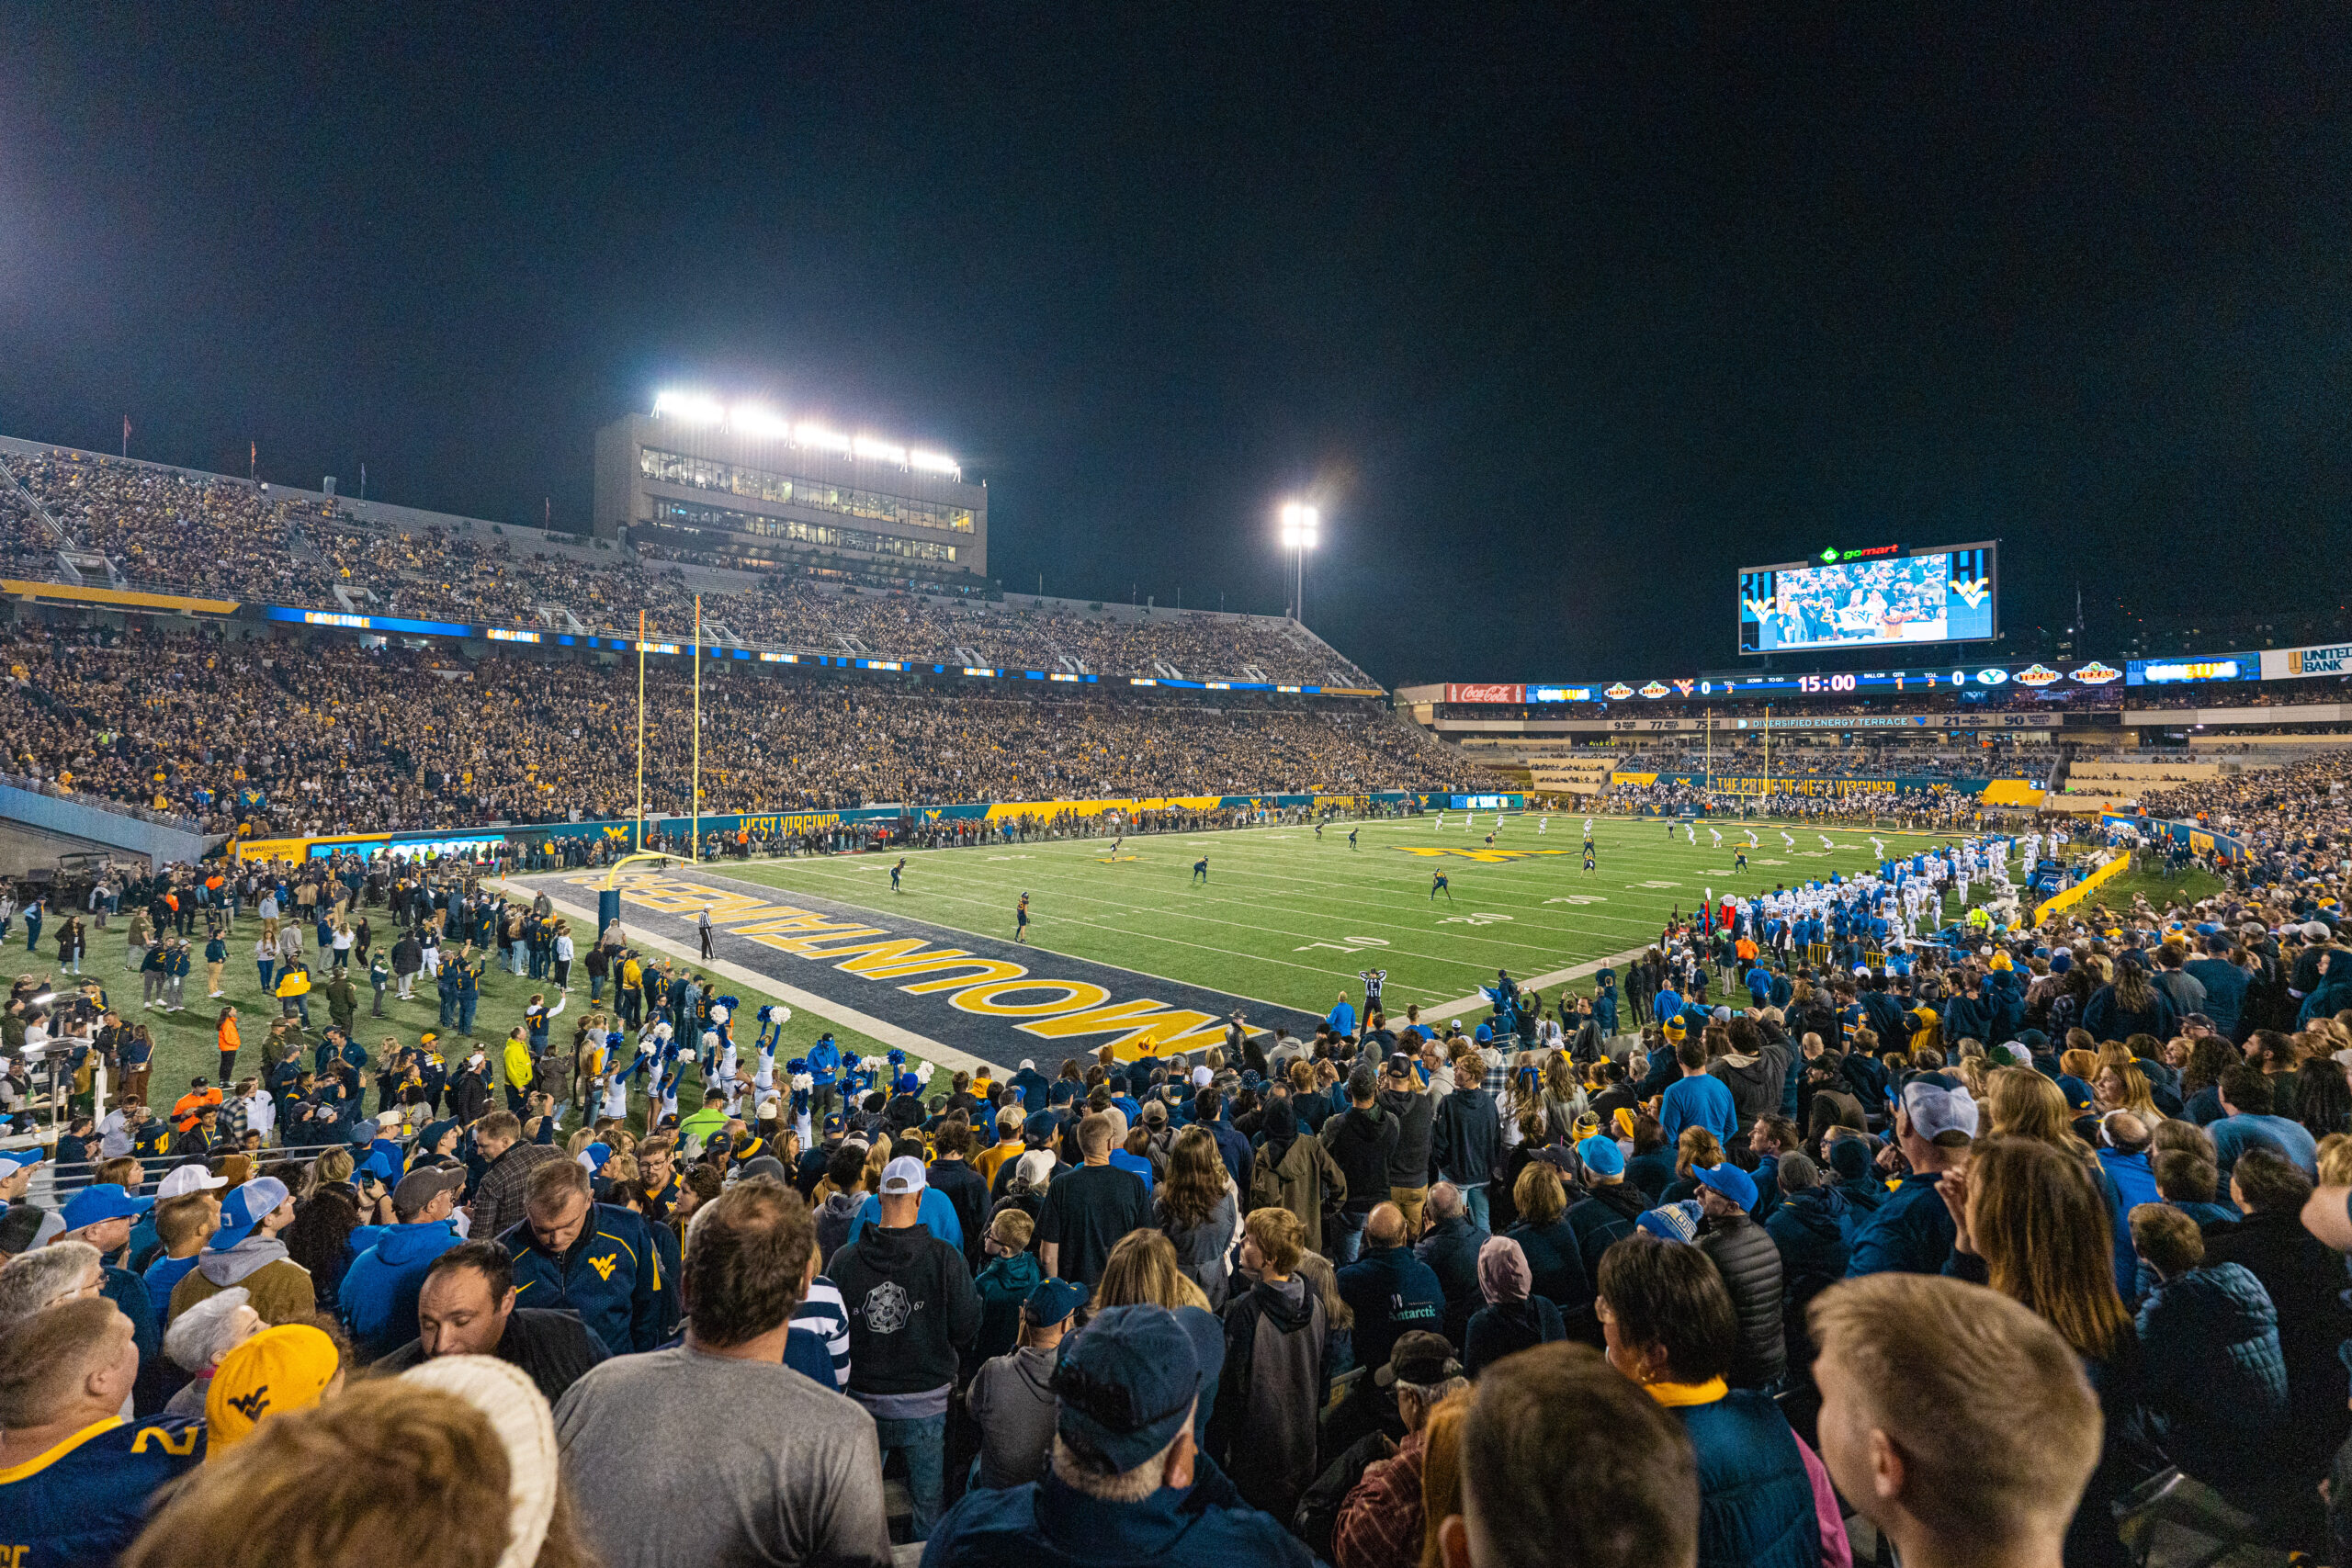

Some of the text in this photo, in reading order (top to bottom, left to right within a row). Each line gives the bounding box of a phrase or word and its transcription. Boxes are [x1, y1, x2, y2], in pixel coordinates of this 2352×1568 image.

[1843, 544, 1899, 560] gomart
[2304, 660, 2344, 672] BANK
[1951, 671, 1965, 685] 0
[1983, 671, 2002, 682] Y
[2019, 671, 2056, 681] TEXAS
[2076, 670, 2115, 679] TEXAS
[1702, 682, 1711, 694] 0
[1798, 674, 1855, 692] 15:00
[1894, 677, 1904, 690] 1
[1928, 678, 1936, 687] 3
[1726, 685, 1734, 694] 3
[1650, 721, 1662, 729] 77
[1695, 720, 1708, 728] 75
[1753, 717, 1908, 728] DIVERSIFIED ENERGY TERRACE
[1943, 716, 1960, 726] 21
[2005, 715, 2025, 726] 90
[1717, 778, 1738, 793] THE
[1741, 778, 1777, 795] PRIDE
[1781, 779, 1796, 795] OF
[2030, 780, 2045, 789] 21
[1885, 901, 1897, 909] 64
[1445, 912, 1513, 926] 20
[1310, 936, 1390, 953] 10
[526, 1014, 543, 1029] 77
[913, 1301, 924, 1311] 67
